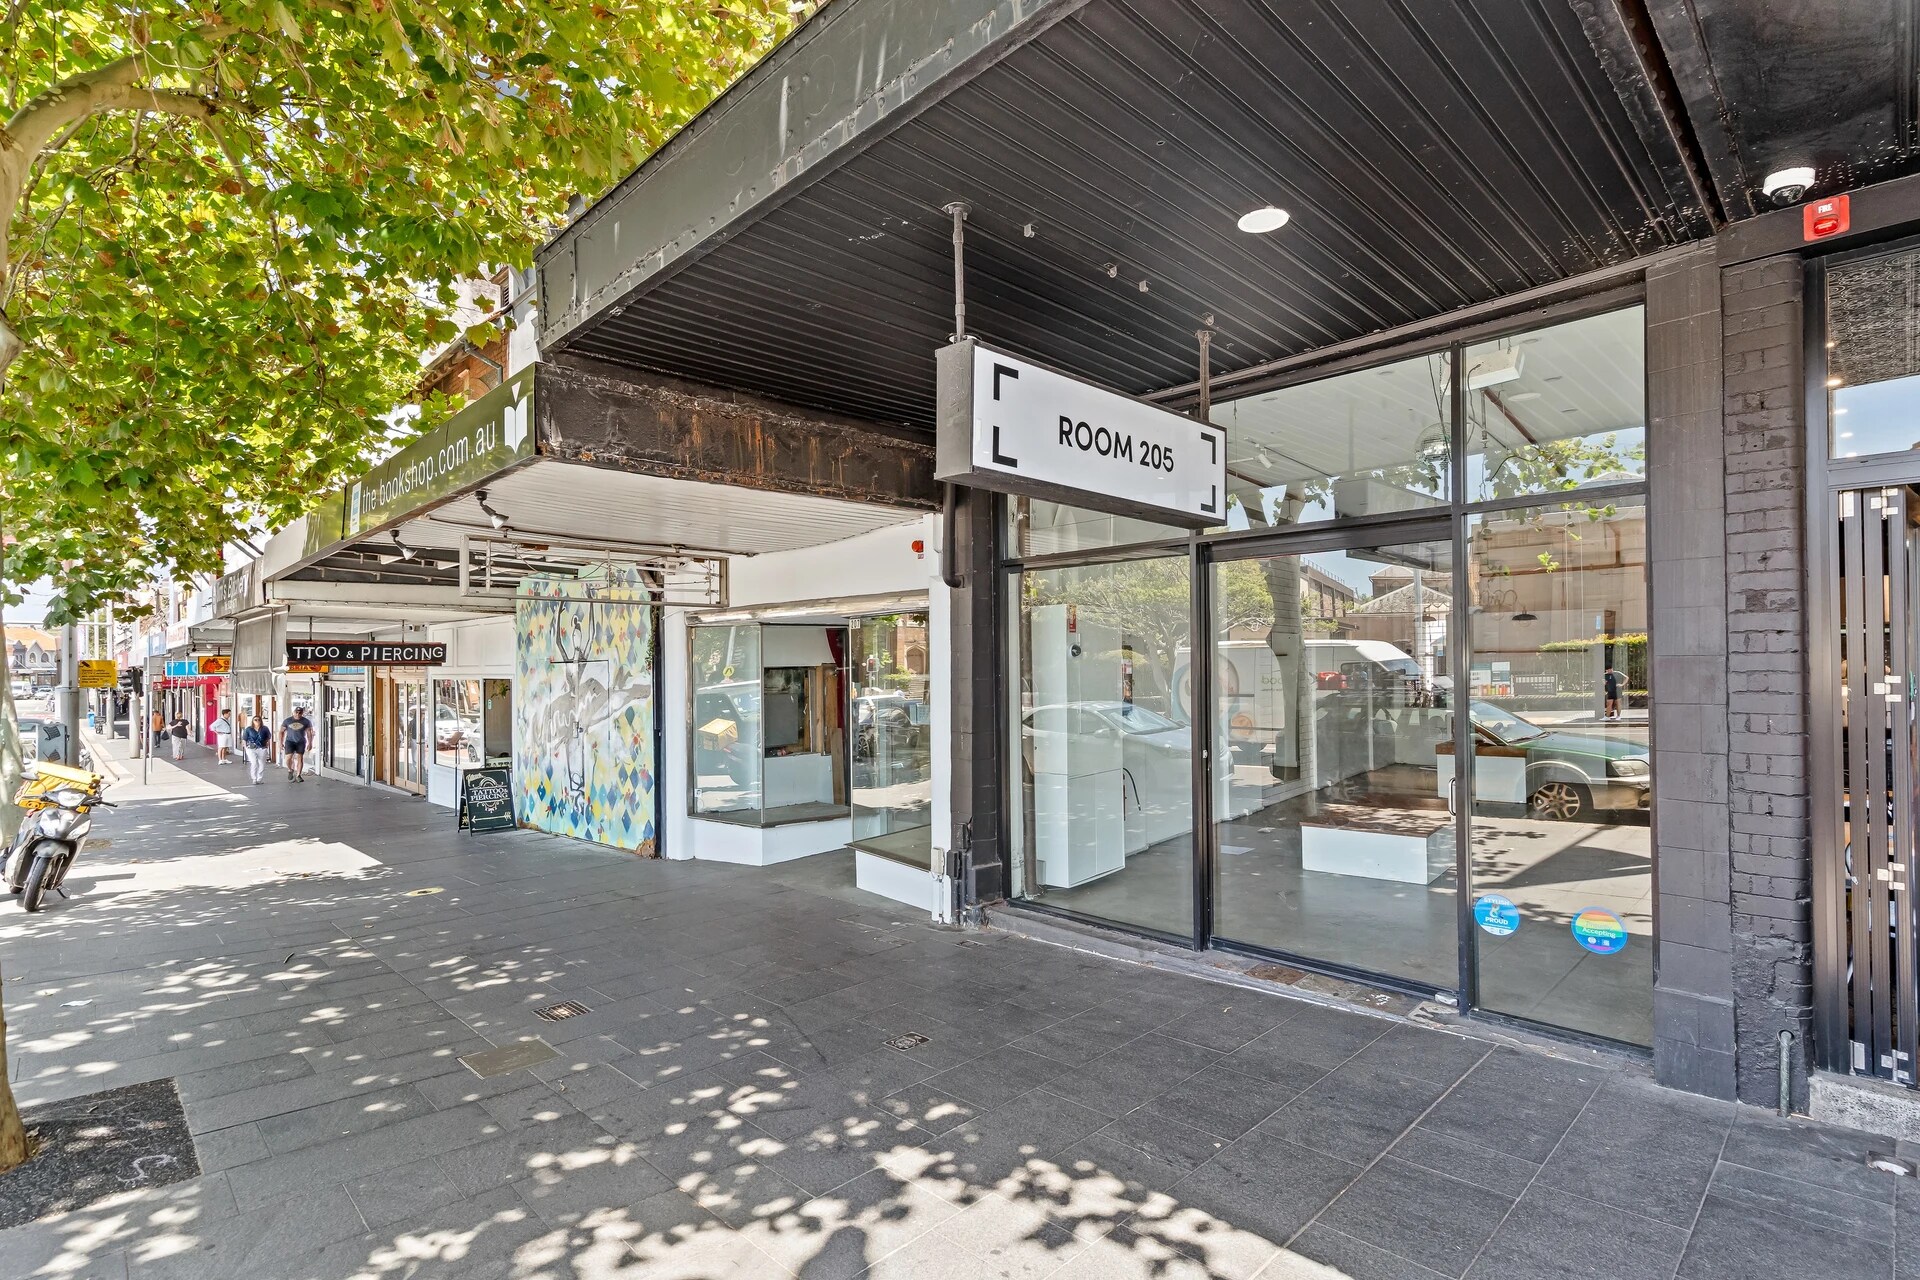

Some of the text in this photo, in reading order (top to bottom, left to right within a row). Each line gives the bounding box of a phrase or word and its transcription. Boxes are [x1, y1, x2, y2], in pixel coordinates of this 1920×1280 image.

[1818, 203, 1833, 213] FIRE
[1058, 415, 1175, 473] ROOM 205
[362, 486, 377, 514] the
[379, 420, 496, 506] bookshop.com.au
[292, 646, 444, 661] TTOO & PIERCING
[471, 787, 505, 796] TATTOO
[470, 793, 509, 801] PIERCING
[1483, 898, 1510, 906] STYLISH
[1484, 916, 1509, 925] PROUD
[1581, 927, 1617, 939] Accepting
